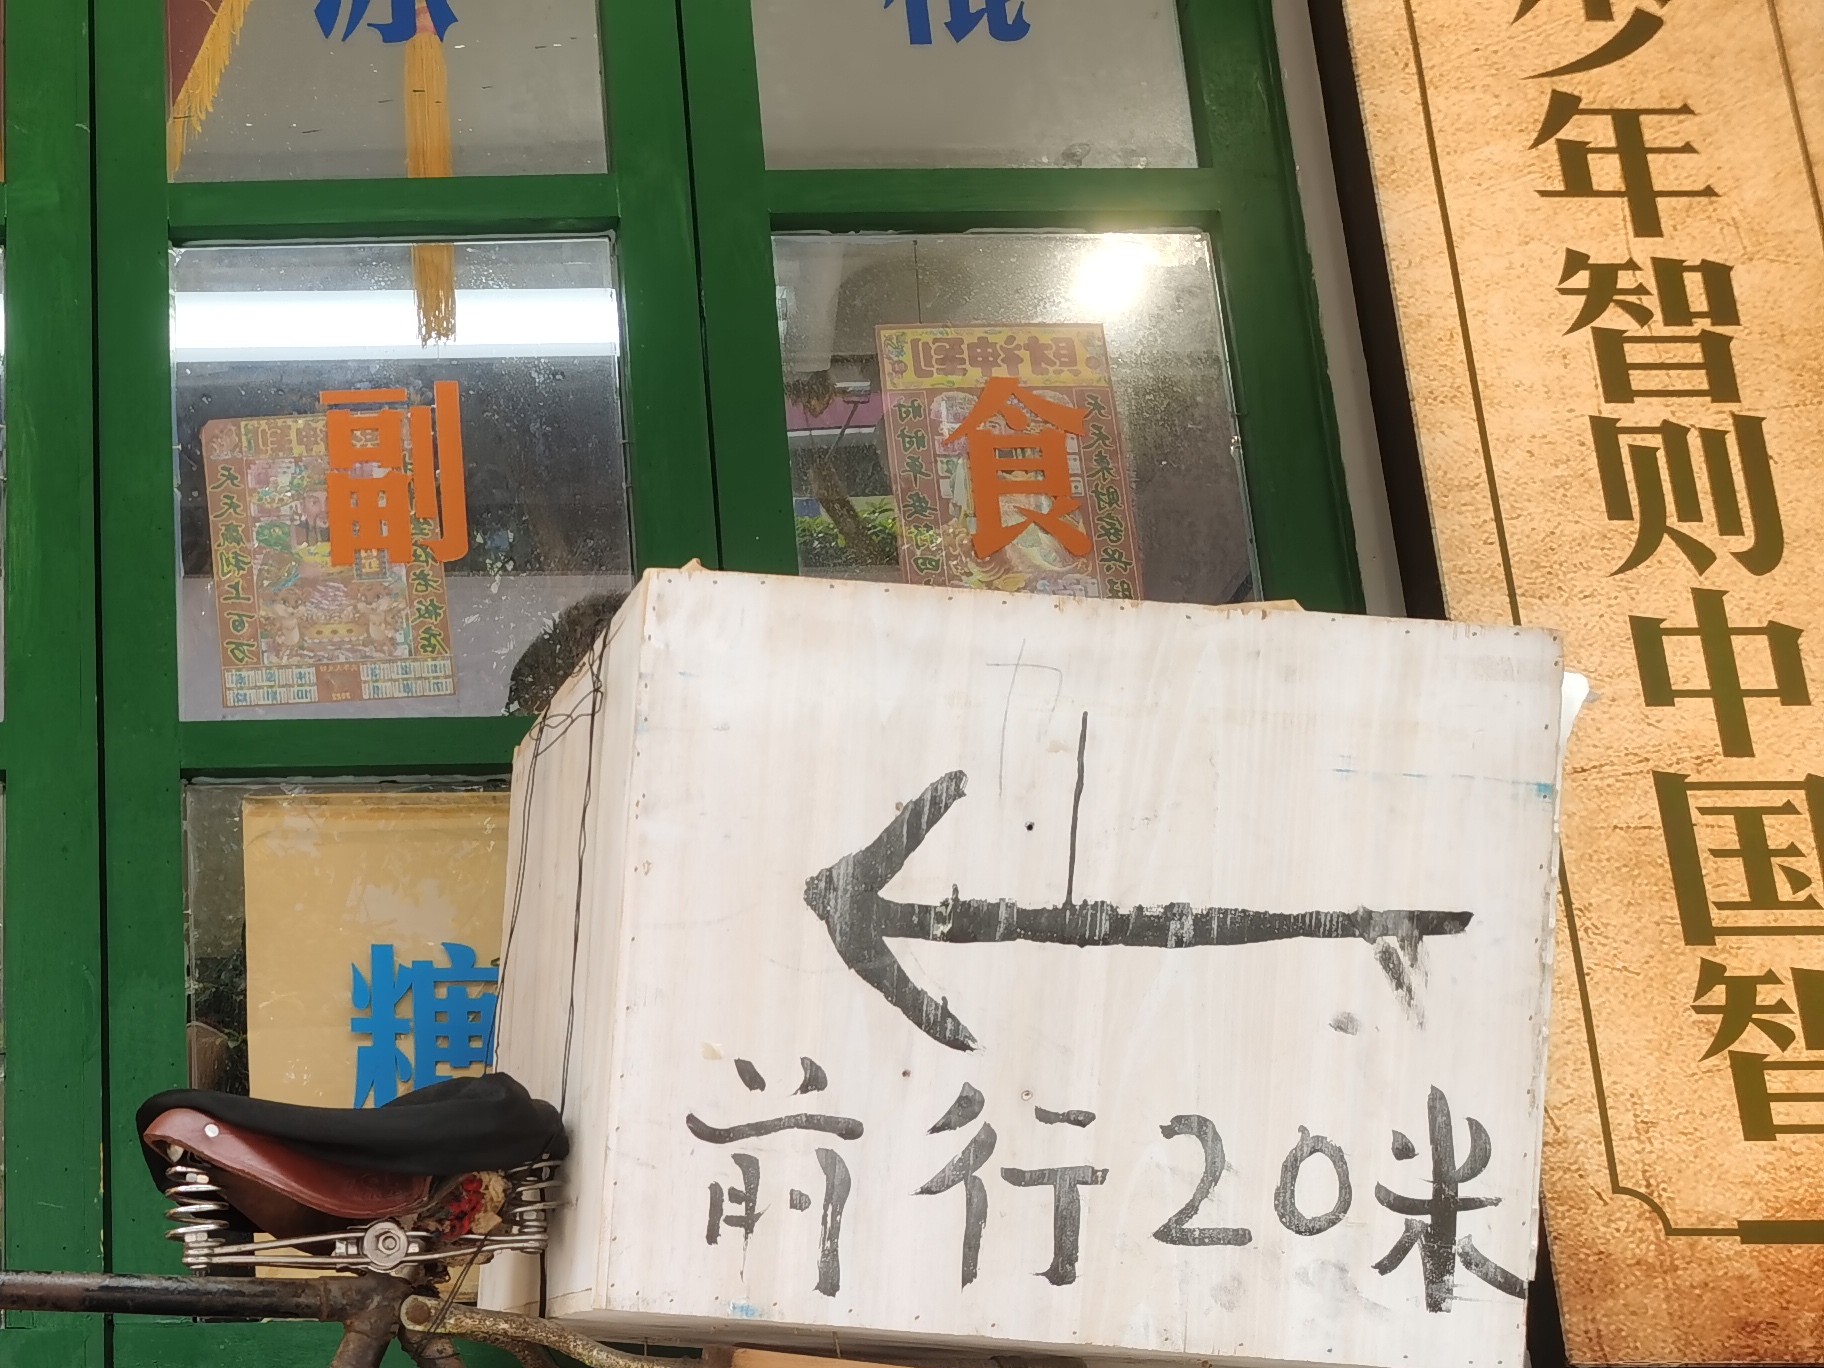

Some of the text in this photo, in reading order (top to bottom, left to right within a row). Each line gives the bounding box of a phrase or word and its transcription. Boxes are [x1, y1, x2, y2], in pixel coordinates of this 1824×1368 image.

[319, 380, 469, 567] 副
[942, 376, 1092, 560] 食
[685, 1056, 1527, 1314] 前行20米
